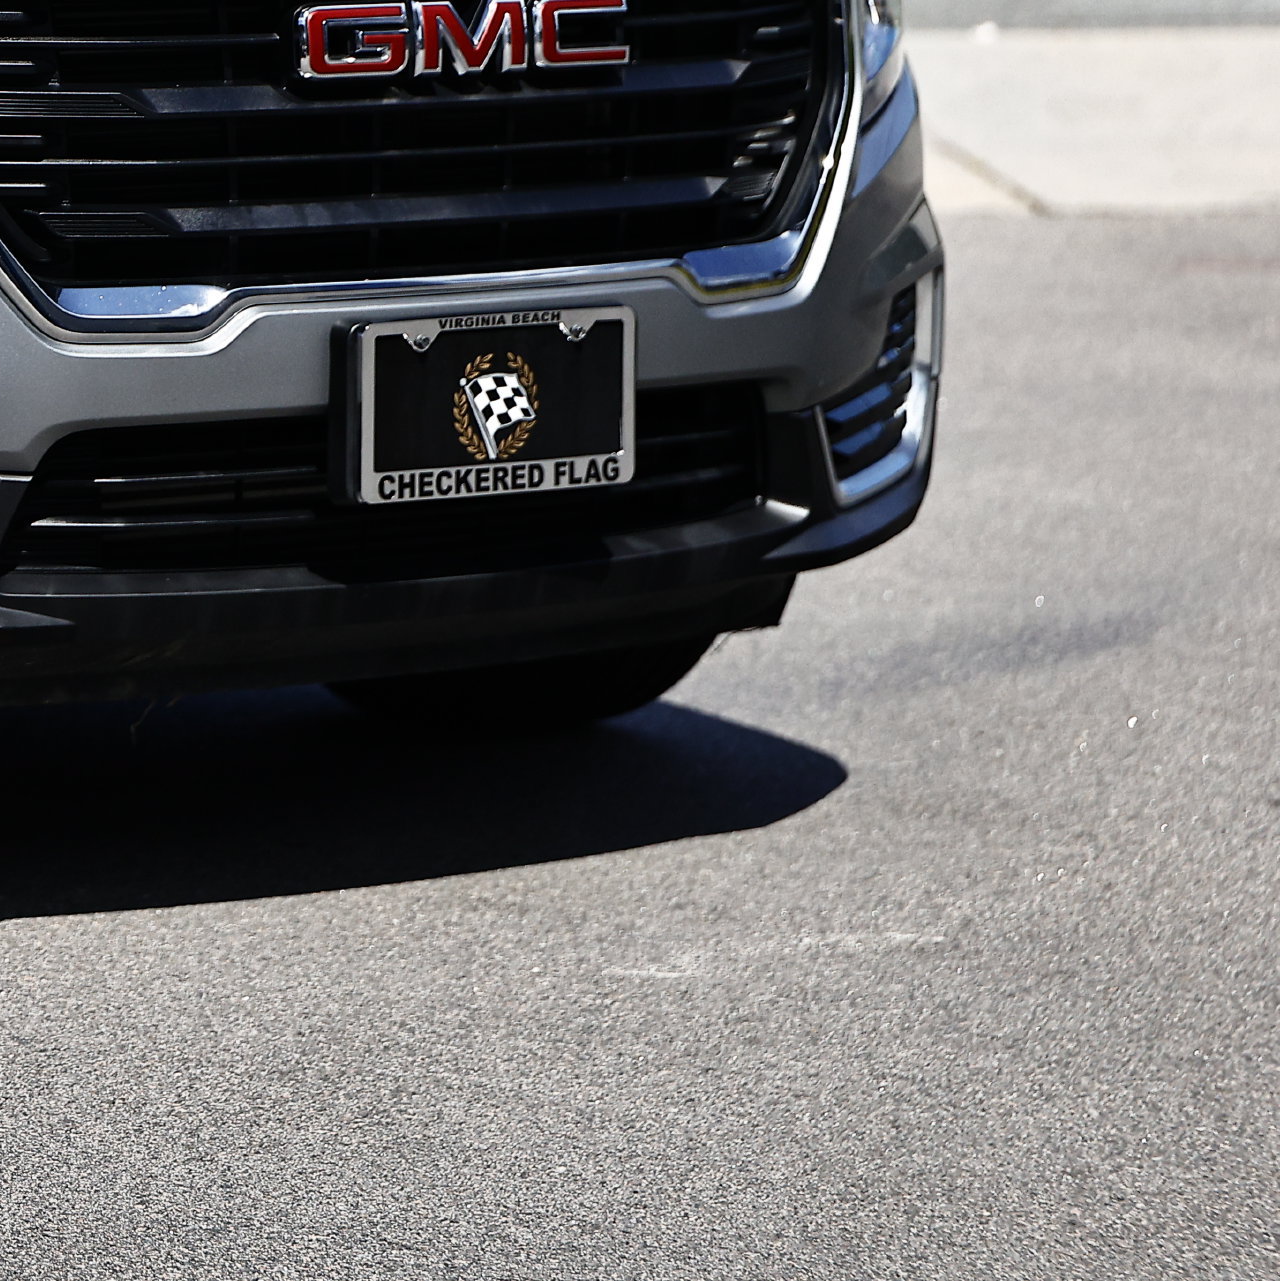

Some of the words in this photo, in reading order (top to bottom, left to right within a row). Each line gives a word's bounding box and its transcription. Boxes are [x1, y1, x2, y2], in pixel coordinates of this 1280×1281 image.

[438, 315, 506, 330] VIRGINIA
[511, 310, 560, 324] BEACH
[377, 463, 544, 500] CHECKERED
[553, 456, 619, 486] FLAG
